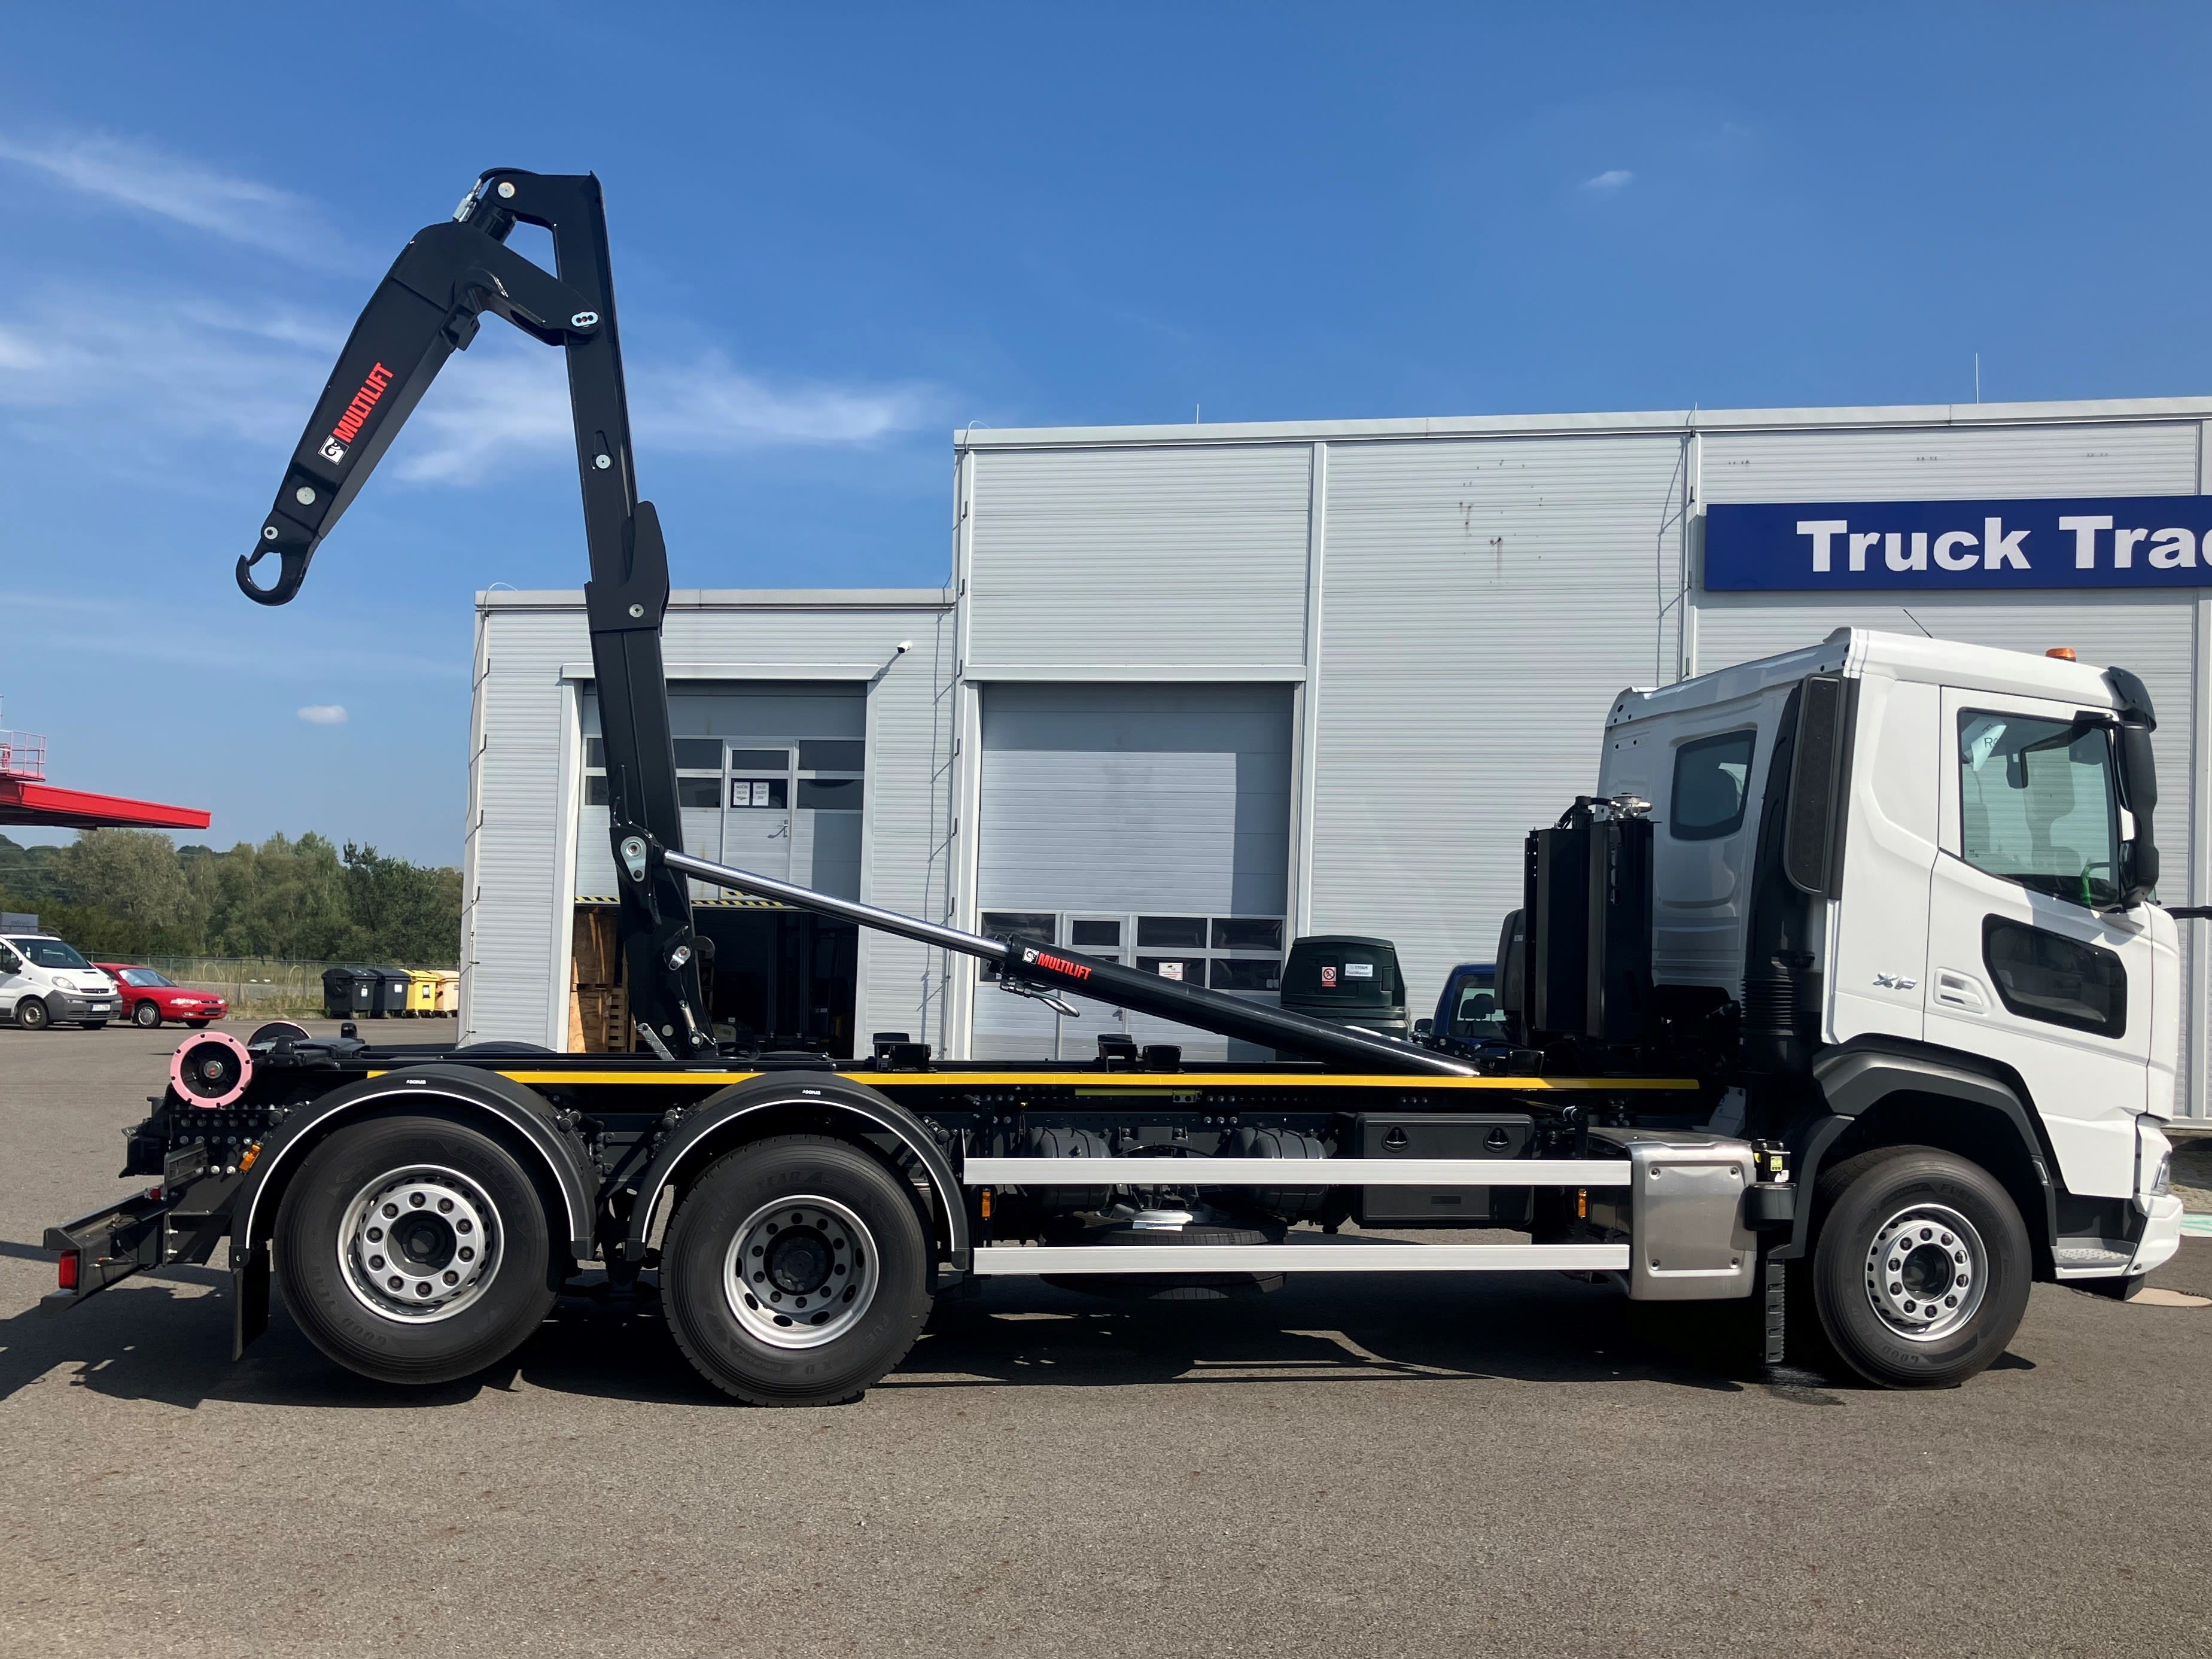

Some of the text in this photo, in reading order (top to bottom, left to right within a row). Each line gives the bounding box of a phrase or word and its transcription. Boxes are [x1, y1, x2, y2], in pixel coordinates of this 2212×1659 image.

[333, 362, 394, 443] MULTILIFT
[1796, 515, 2212, 573] Truck Tra
[1037, 952, 1092, 981] MULTILIFT
[1872, 971, 1918, 990] XF
